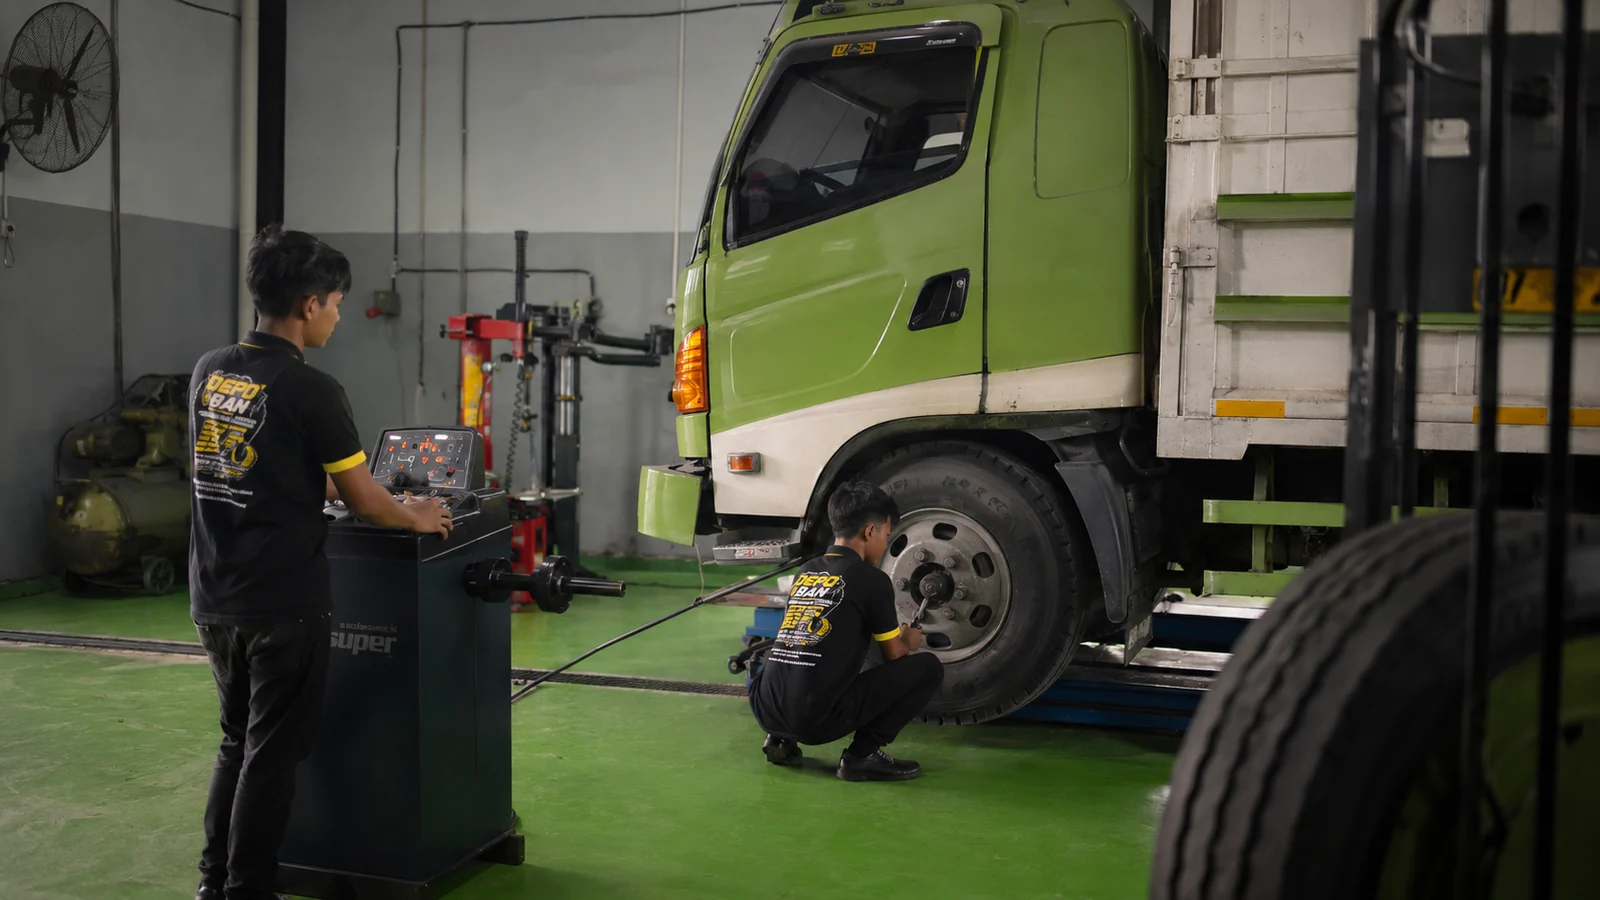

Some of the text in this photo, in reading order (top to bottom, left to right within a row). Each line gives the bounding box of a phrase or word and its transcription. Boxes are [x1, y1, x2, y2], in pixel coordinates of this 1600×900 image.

[206, 374, 261, 400] DEPO
[208, 393, 251, 414] BAN
[795, 574, 840, 588] DEPO
[794, 586, 830, 598] BAN
[330, 631, 397, 655] super
